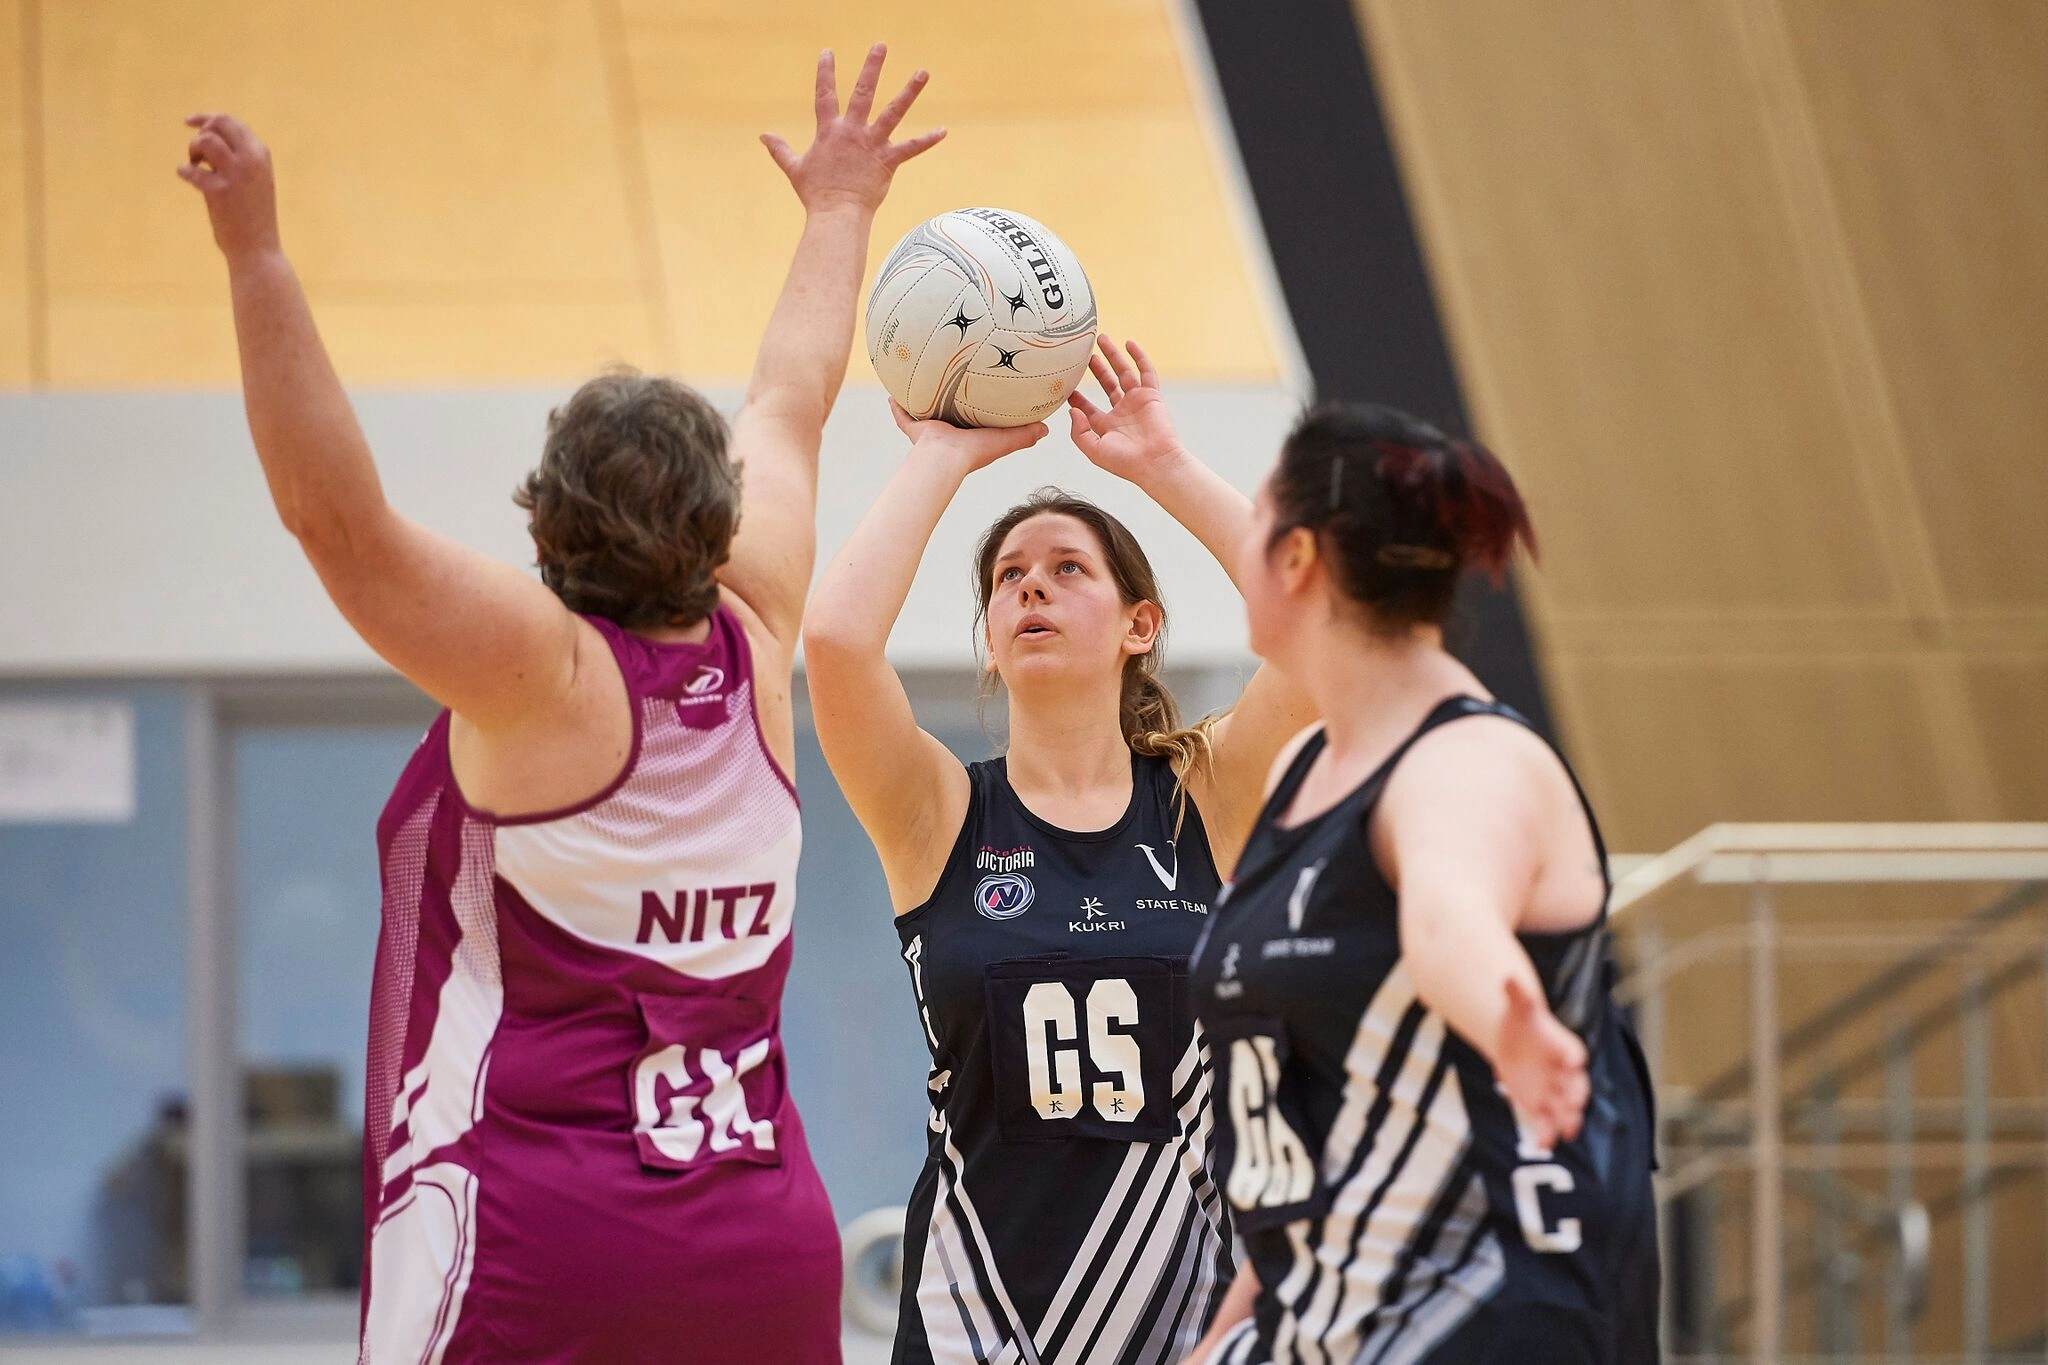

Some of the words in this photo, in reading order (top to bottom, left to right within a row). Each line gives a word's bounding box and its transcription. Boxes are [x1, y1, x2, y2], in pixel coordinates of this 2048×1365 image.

[976, 850, 1035, 873] VICTORIA
[636, 882, 776, 944] NITZ
[1136, 899, 1179, 910] STATE
[1180, 899, 1208, 915] TEAM
[1068, 920, 1126, 932] KUKRI
[1022, 978, 1146, 1123] GS
